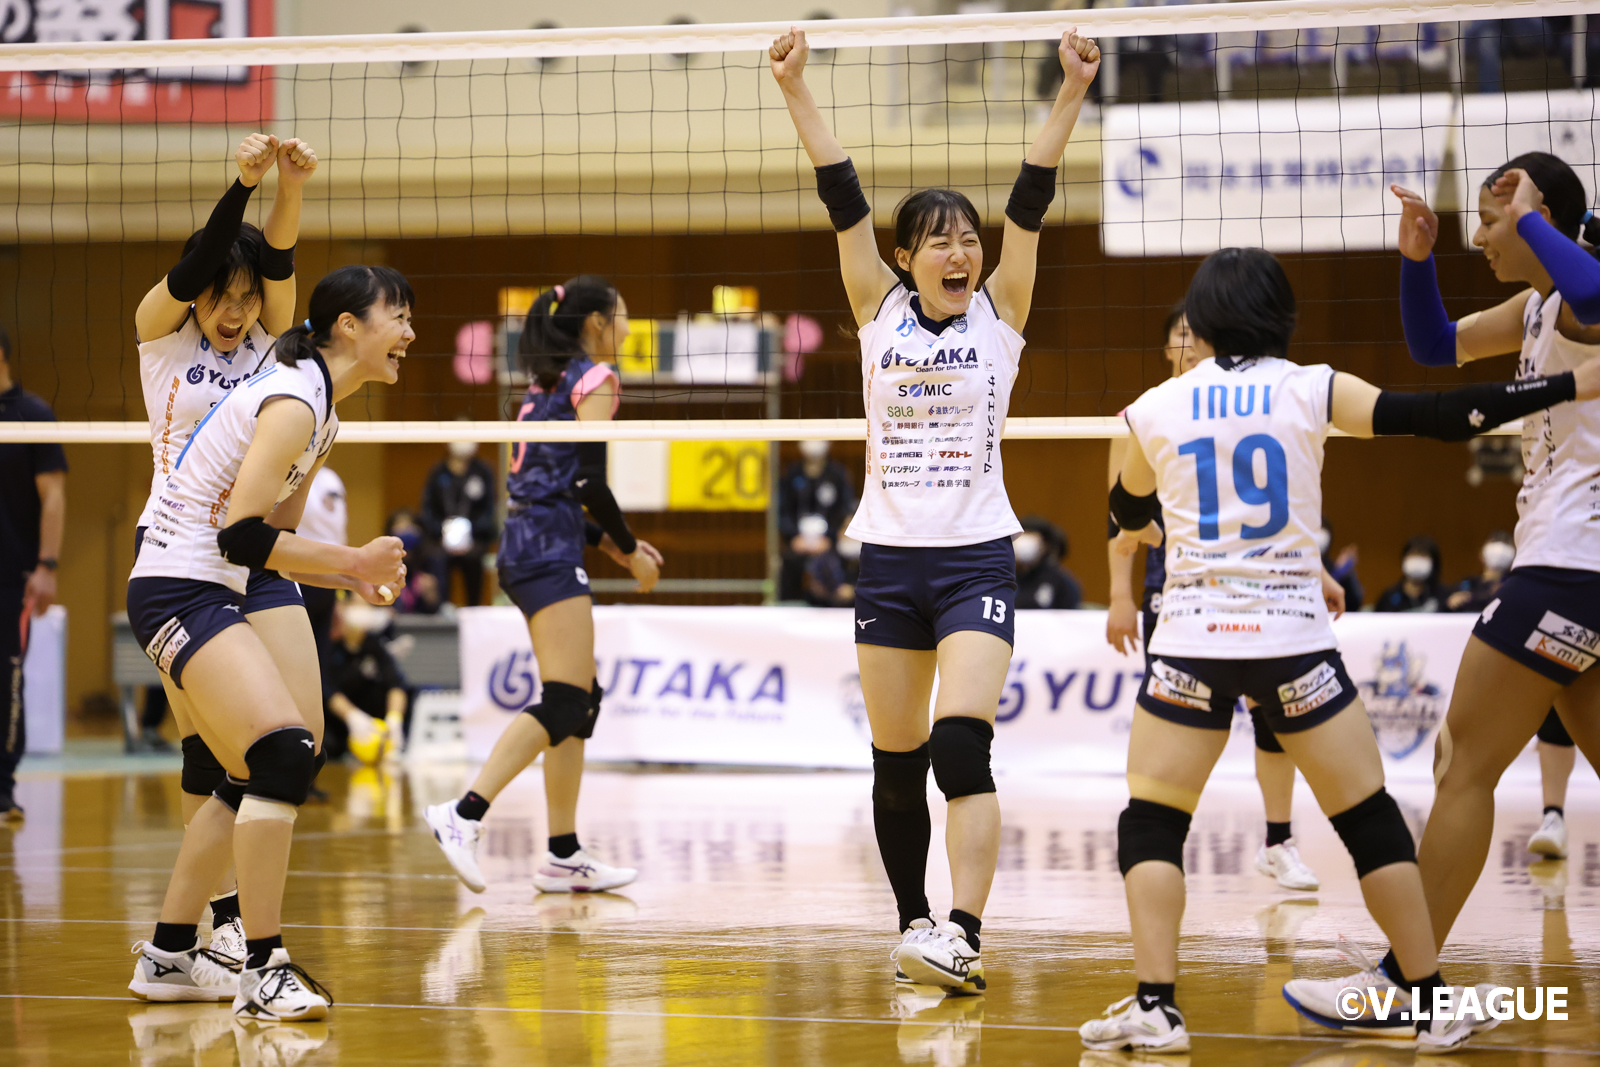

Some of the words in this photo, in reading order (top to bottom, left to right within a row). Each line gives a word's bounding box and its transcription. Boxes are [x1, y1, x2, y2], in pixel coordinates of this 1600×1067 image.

[958, 362, 979, 370] Future
[898, 381, 953, 397] SOMIC
[935, 404, 974, 415] 遠鉄グループ
[983, 375, 996, 474] サイエンスホーム
[938, 450, 973, 459] マストレ
[700, 446, 768, 501] 20
[889, 465, 921, 474] バンテリン
[937, 479, 971, 488] 森島学園
[1178, 432, 1290, 541] 19
[981, 596, 1007, 624] 13
[1219, 623, 1261, 633] YAMAHA
[594, 658, 787, 704] UTAKA
